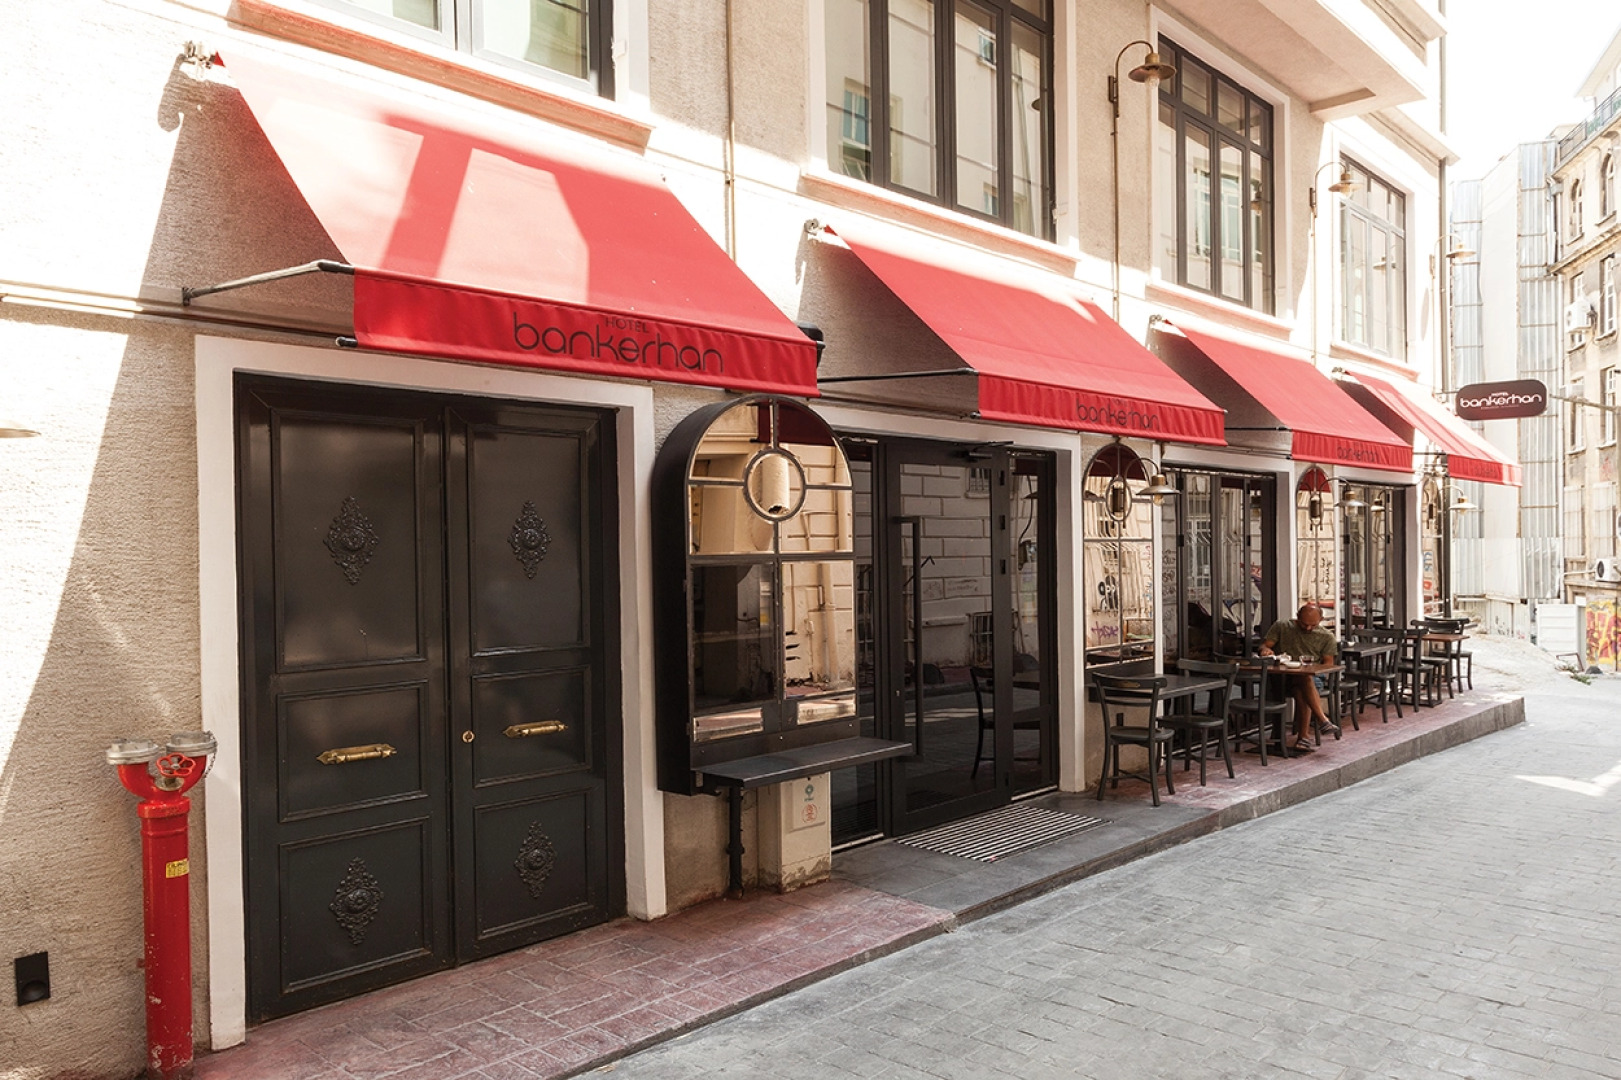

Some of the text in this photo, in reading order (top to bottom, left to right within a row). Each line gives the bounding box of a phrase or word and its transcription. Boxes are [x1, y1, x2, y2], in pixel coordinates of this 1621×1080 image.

[604, 315, 650, 334] HOTEL
[513, 311, 724, 373] bankerhan
[1459, 393, 1542, 408] bankerhan
